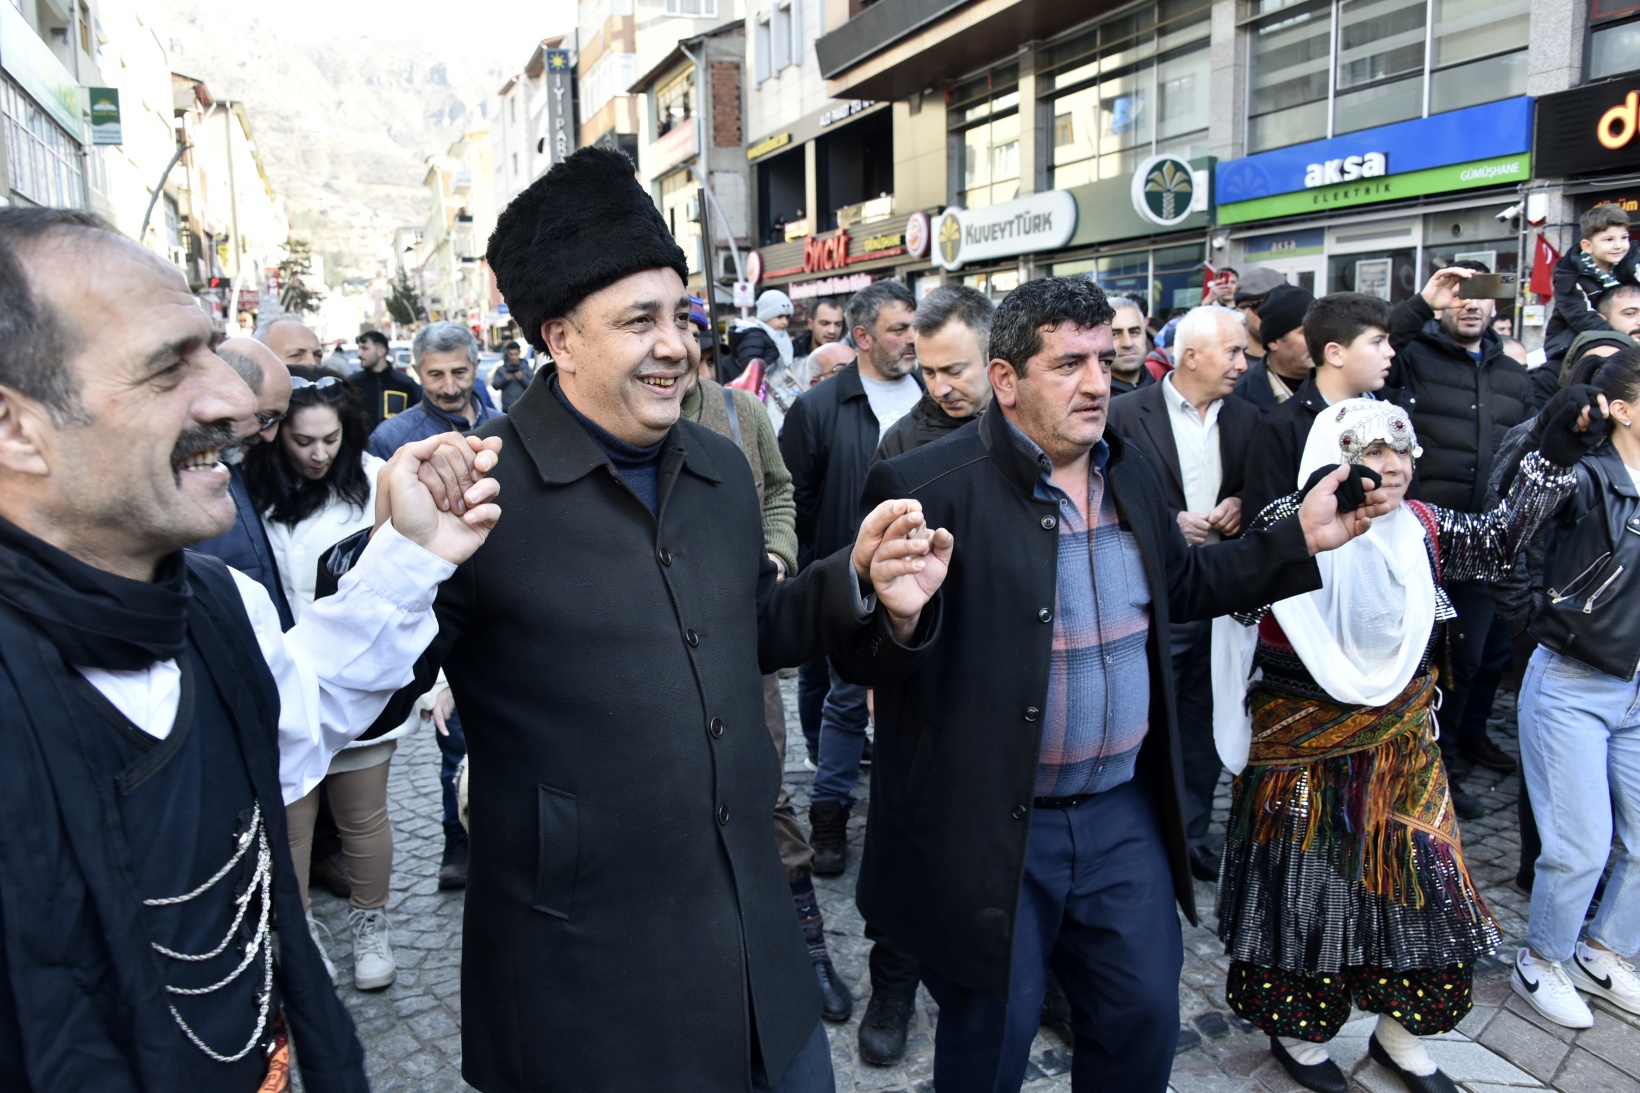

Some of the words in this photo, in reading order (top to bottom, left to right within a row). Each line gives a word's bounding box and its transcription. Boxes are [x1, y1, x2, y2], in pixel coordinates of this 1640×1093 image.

[1597, 89, 1640, 150] d
[1304, 151, 1387, 188] aksa
[1460, 161, 1520, 182] GÜMÜŞHANE
[1313, 182, 1392, 205] ELEKTRİK
[1270, 239, 1297, 252] aksa
